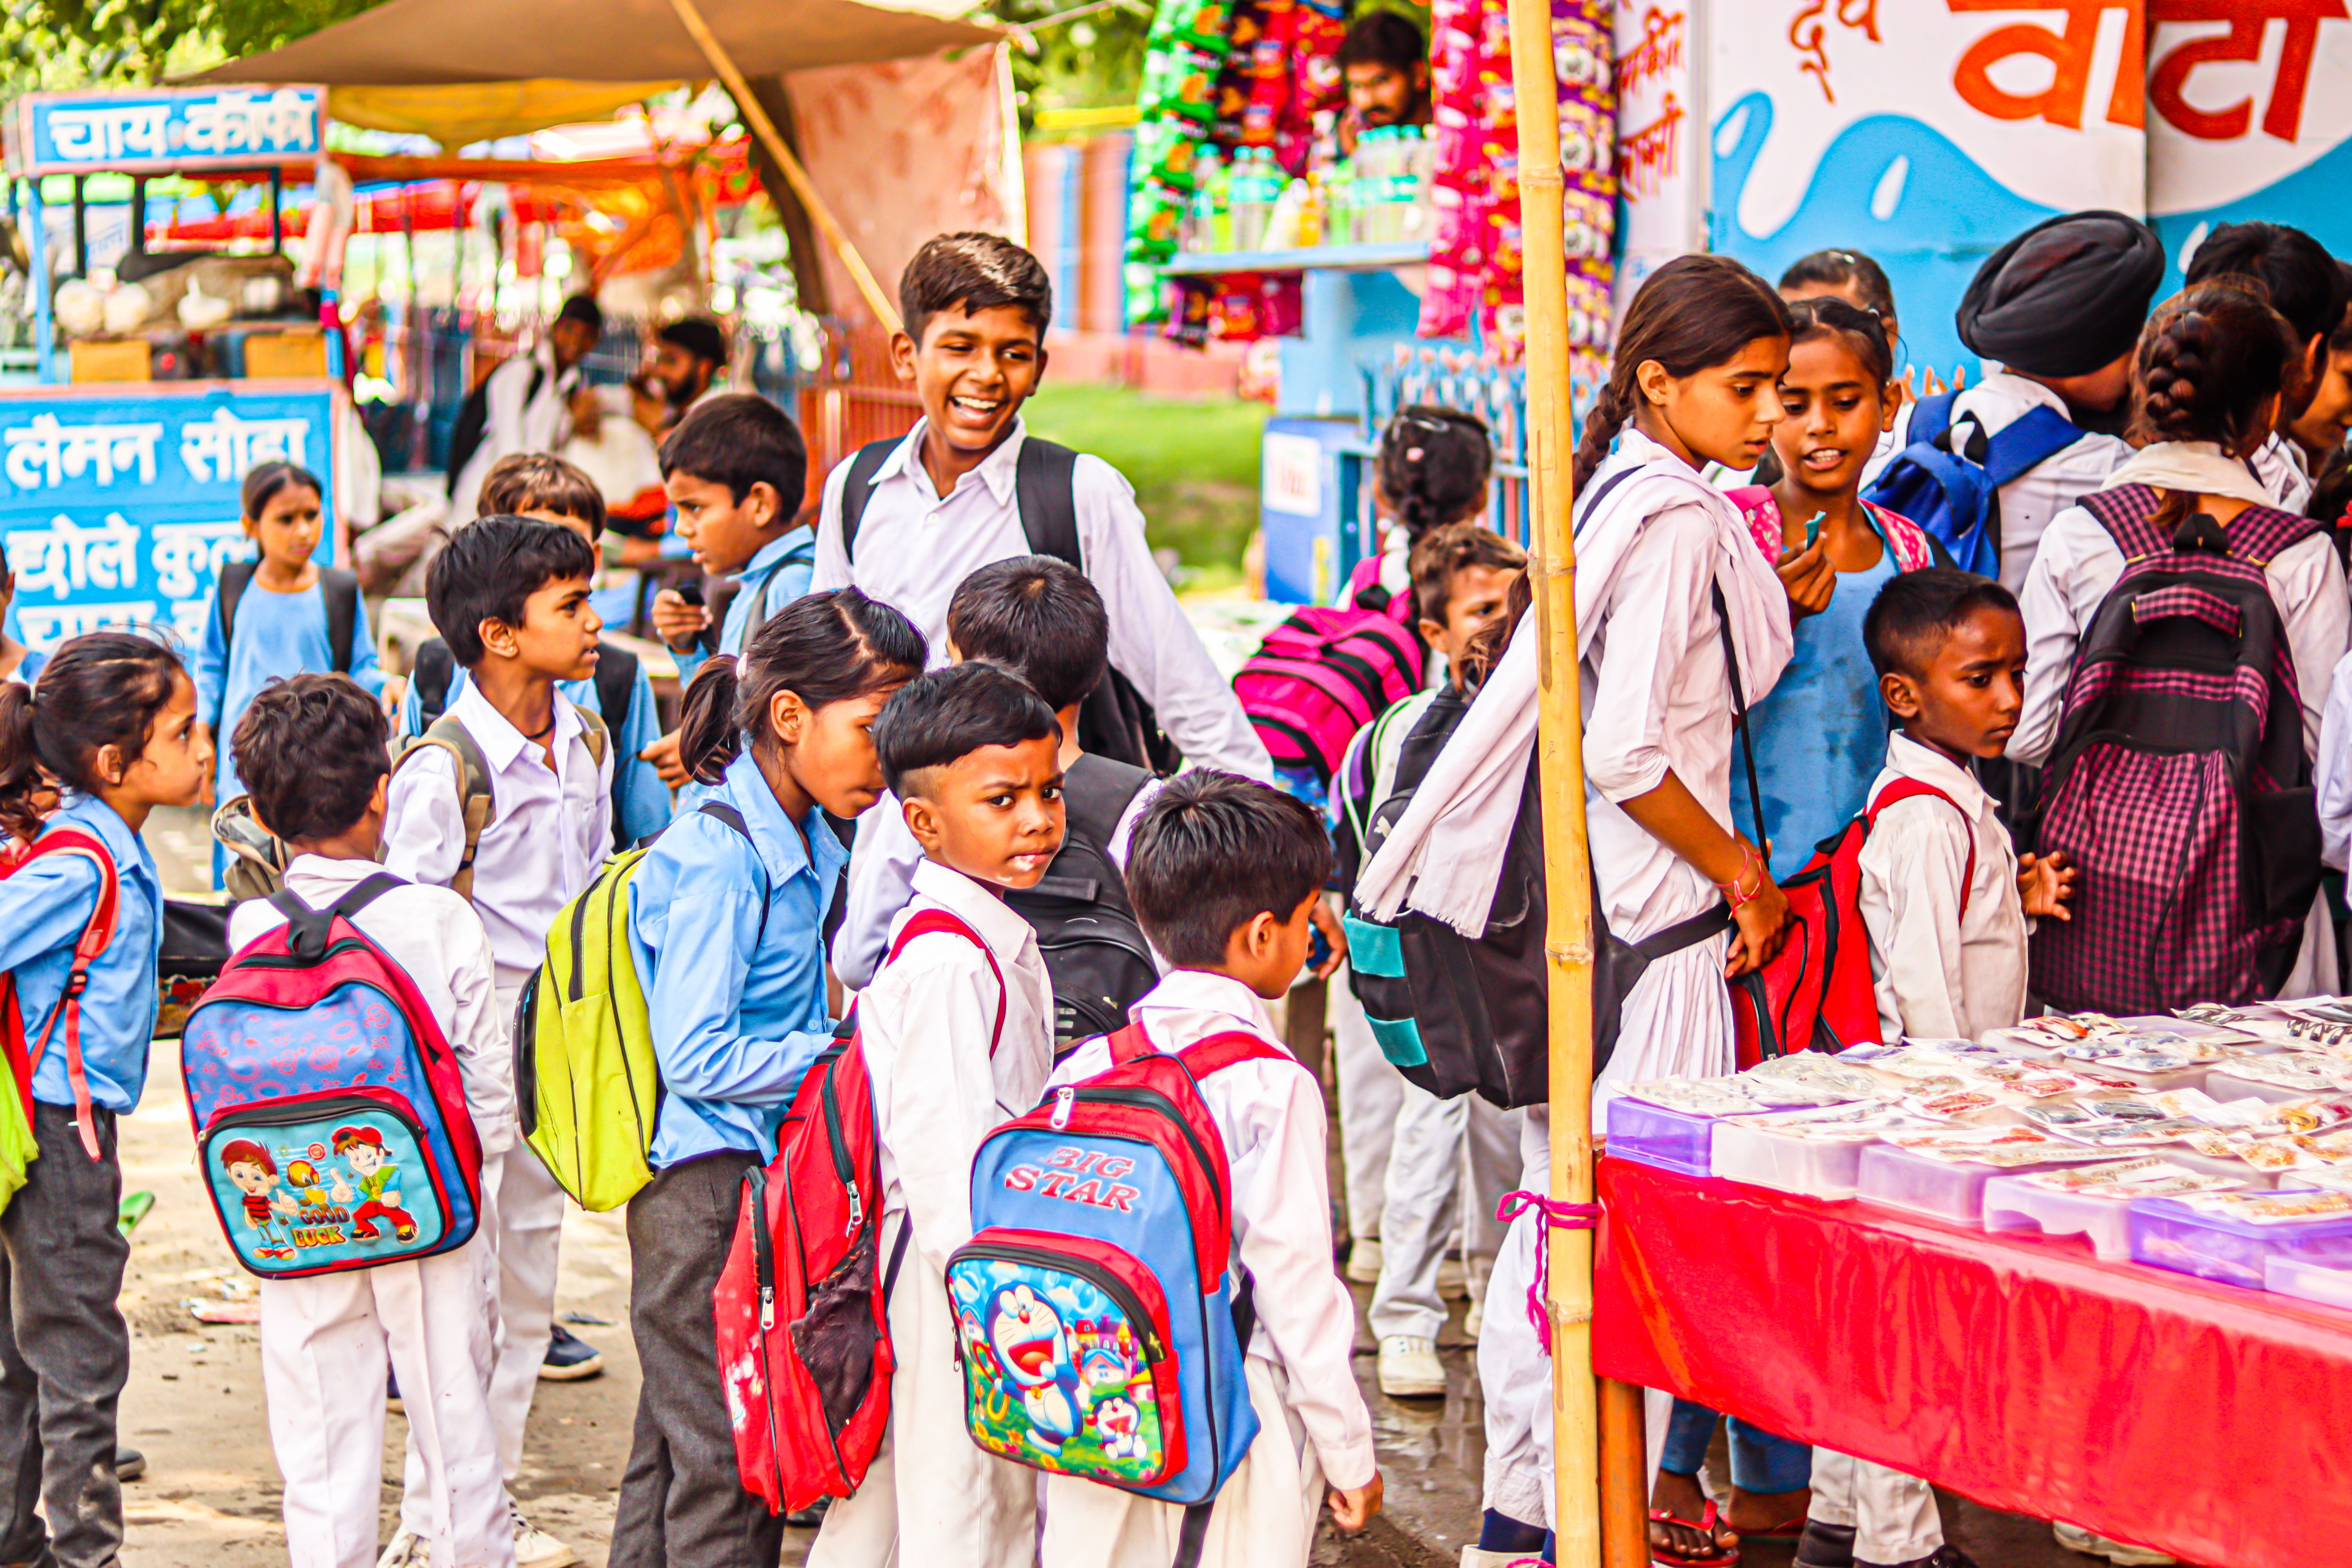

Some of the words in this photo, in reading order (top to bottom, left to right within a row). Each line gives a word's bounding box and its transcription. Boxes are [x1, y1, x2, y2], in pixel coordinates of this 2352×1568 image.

[47, 105, 171, 160] चाय
[1036, 1145, 1136, 1179] BIG
[1005, 1163, 1141, 1213] STAR
[298, 1205, 350, 1225] GOOD
[290, 1225, 347, 1248] LUCK
